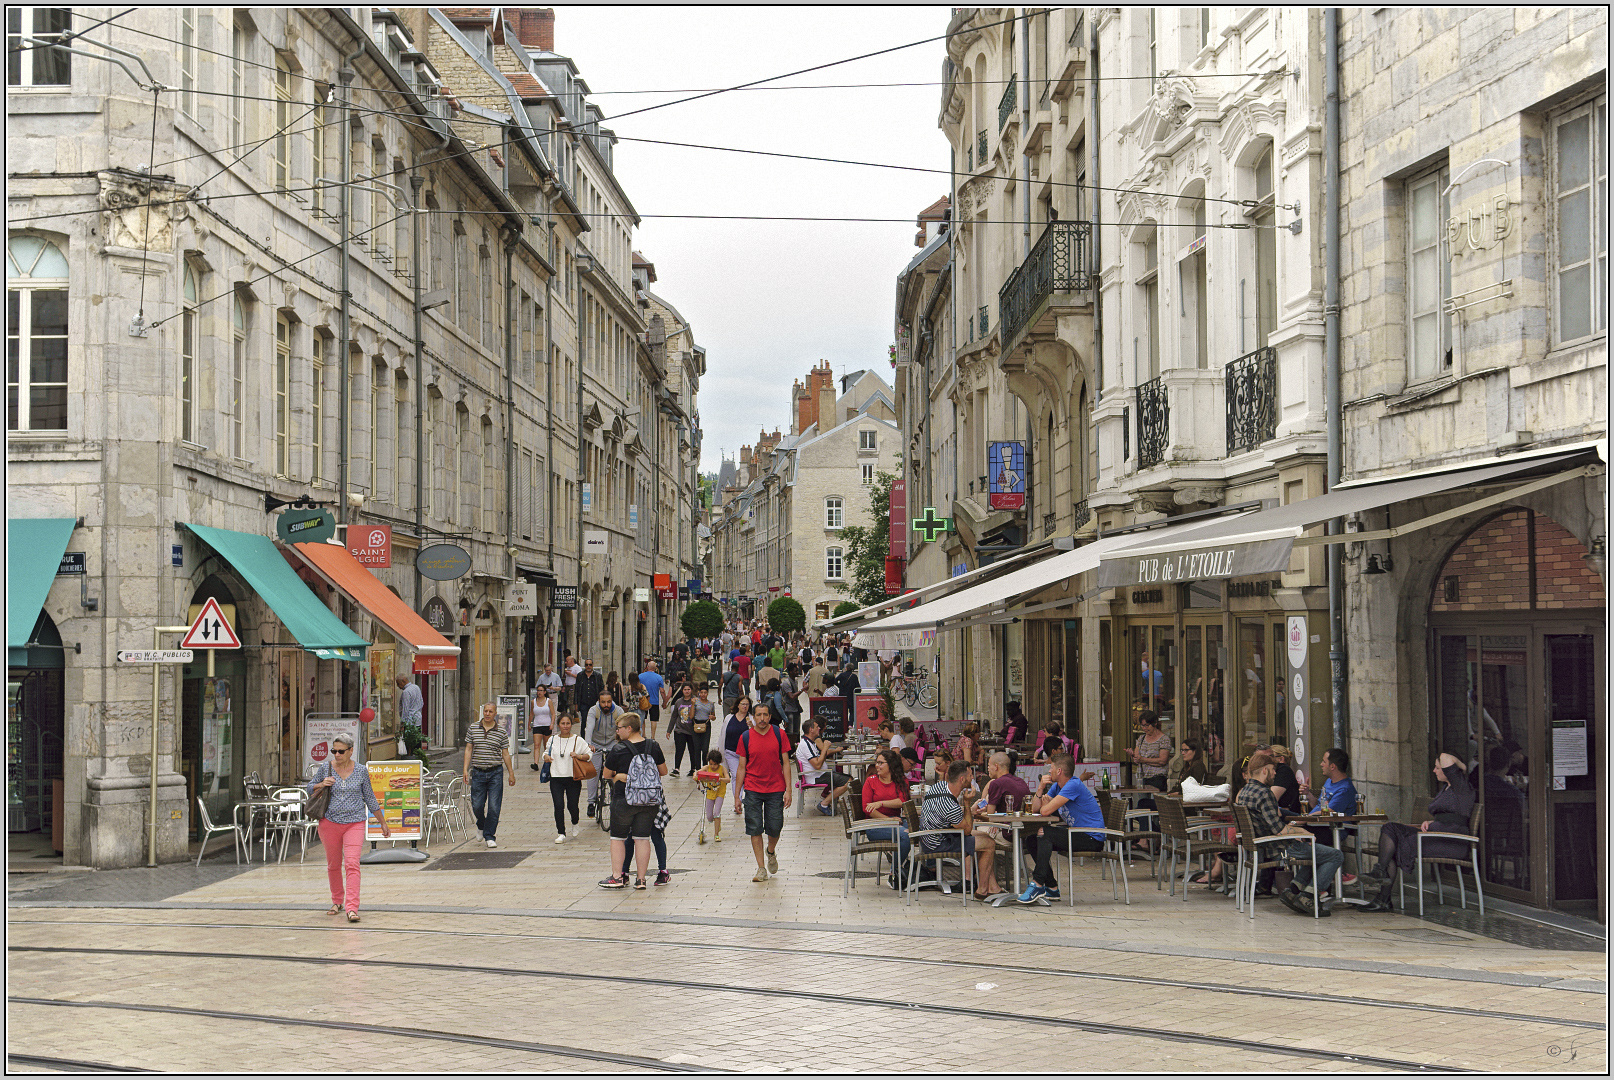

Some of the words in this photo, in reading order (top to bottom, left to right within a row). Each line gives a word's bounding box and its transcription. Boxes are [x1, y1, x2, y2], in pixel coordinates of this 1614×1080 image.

[1445, 193, 1513, 262] PUB
[290, 517, 321, 533] SUBWAY
[61, 555, 75, 563] RUE
[352, 548, 386, 556] SAINT
[1138, 558, 1159, 583] PUB
[1162, 557, 1174, 581] de
[1176, 550, 1235, 580] L'ETOILE
